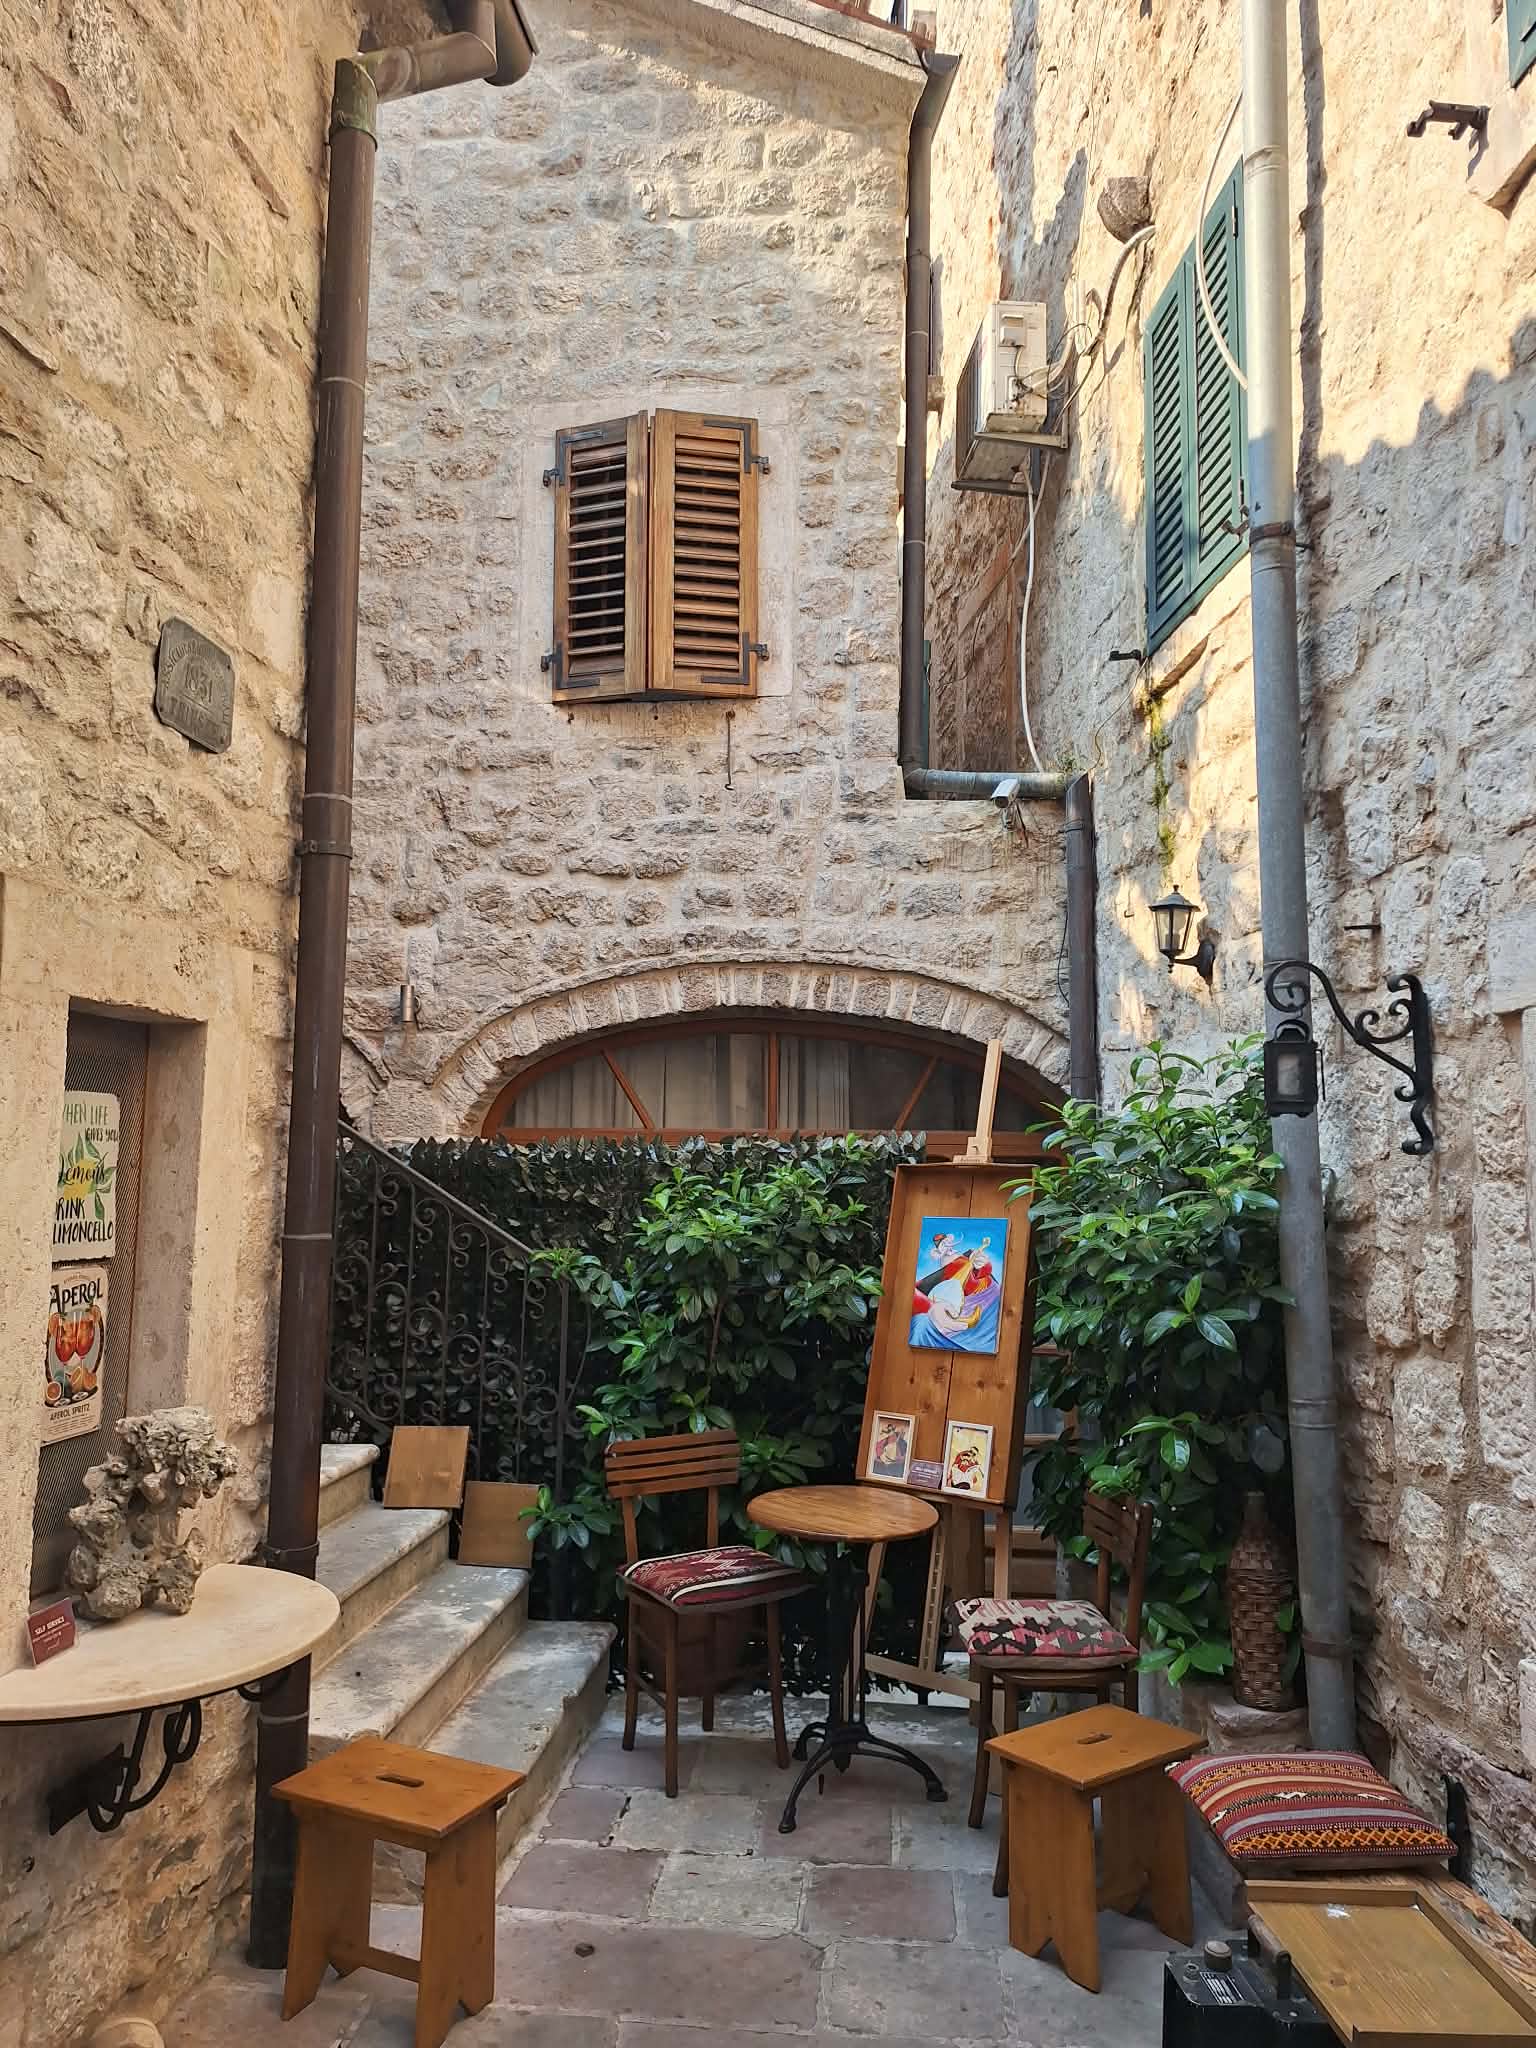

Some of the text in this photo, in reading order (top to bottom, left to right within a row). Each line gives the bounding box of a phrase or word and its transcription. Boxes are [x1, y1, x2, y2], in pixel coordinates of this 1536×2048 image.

[90, 1105, 108, 1126] LIFE
[52, 1221, 114, 1245] LIMONCELLO
[49, 1278, 103, 1315] APEROL
